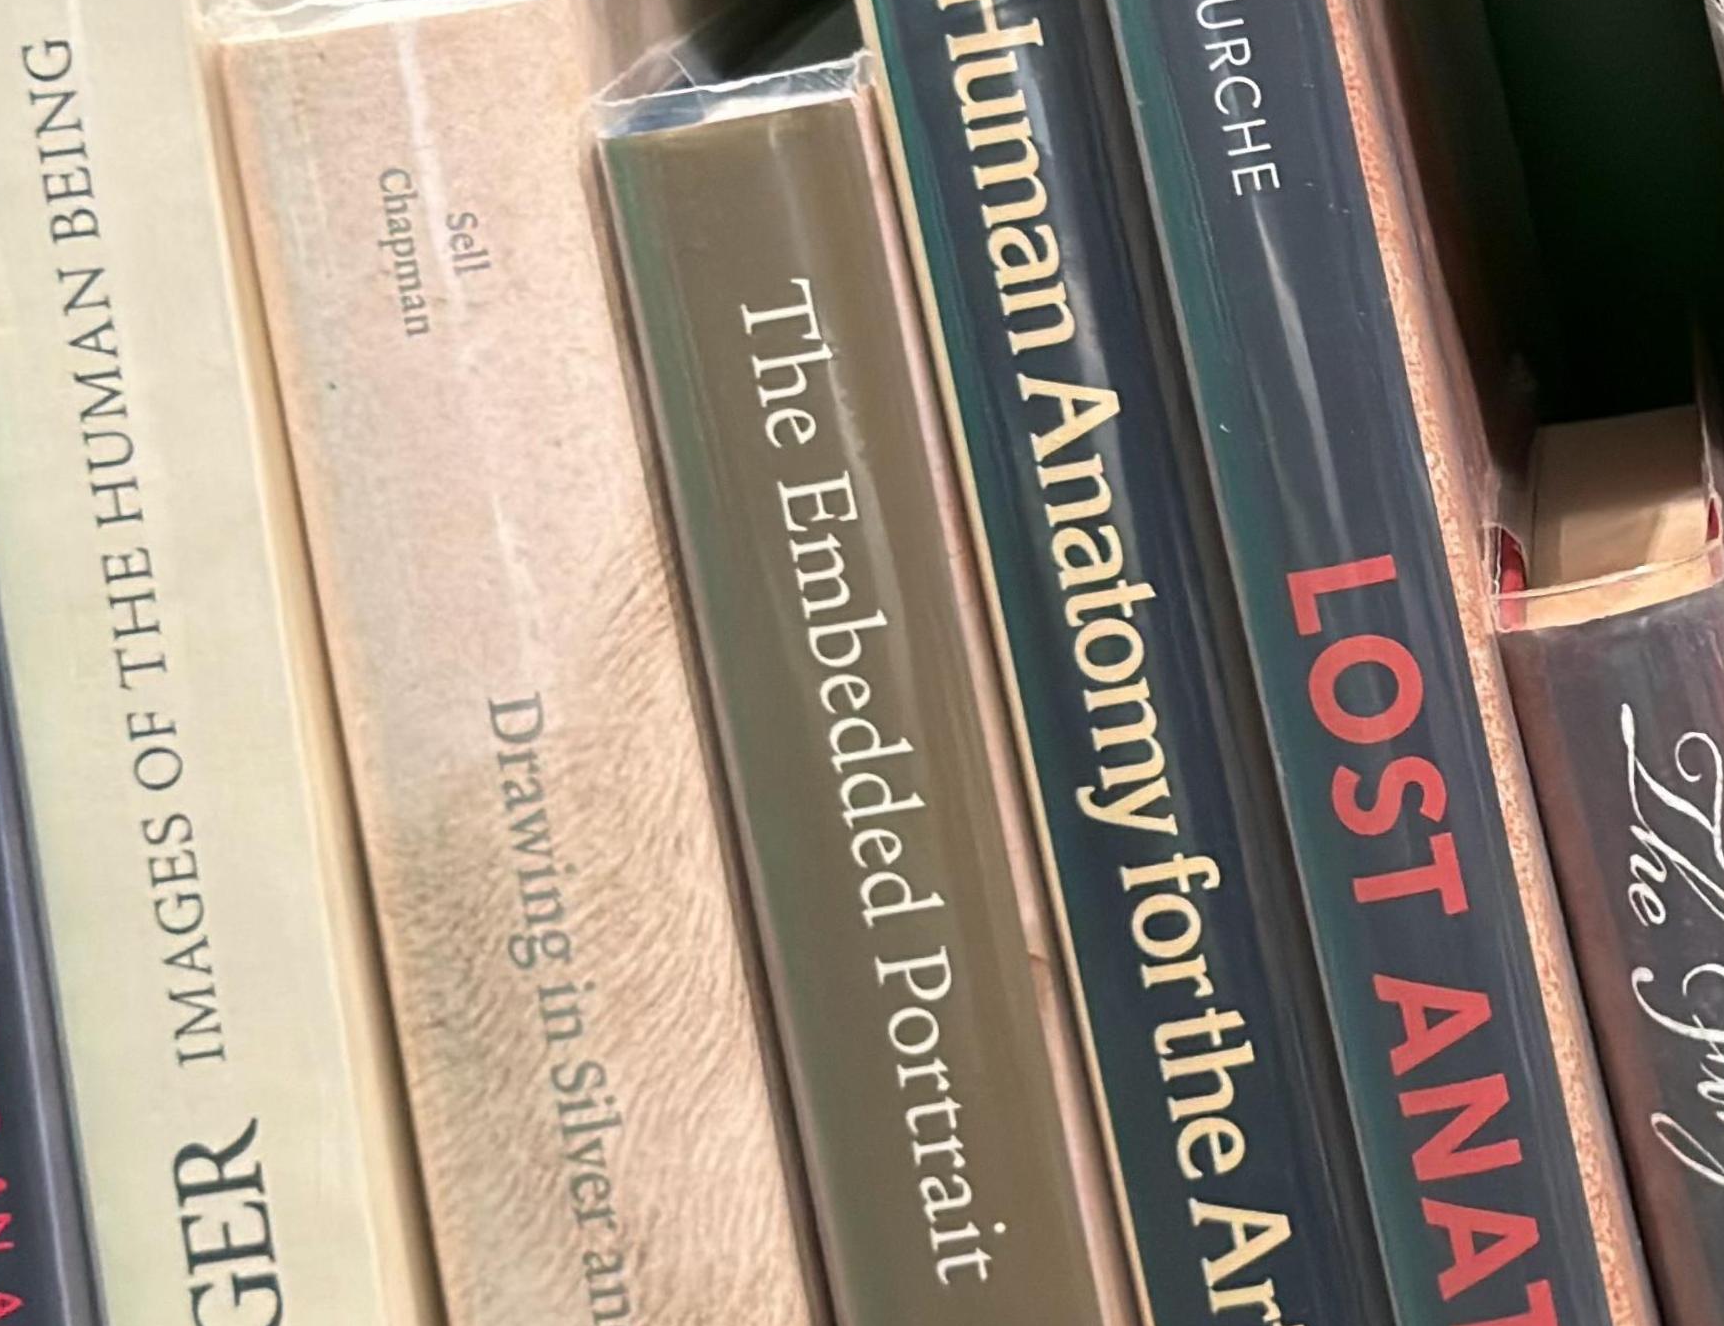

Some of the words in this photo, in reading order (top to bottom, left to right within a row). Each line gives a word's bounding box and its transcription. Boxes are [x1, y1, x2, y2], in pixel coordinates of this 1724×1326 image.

[21, 35, 101, 250] BEING
[377, 166, 430, 338] Chapman
[445, 210, 492, 277] Sell
[56, 265, 146, 528] HUMAN
[738, 275, 838, 449] The
[103, 545, 169, 690] THE
[1016, 369, 1181, 838] Anatomy
[125, 705, 185, 793] OF
[774, 469, 946, 931] Embedded
[1283, 554, 1471, 923] LOST
[487, 689, 577, 972] Drawing
[141, 810, 228, 1069] IMAGES
[537, 979, 597, 1046] in
[1117, 850, 1223, 1003] for
[549, 1056, 624, 1233] Silver
[874, 943, 1008, 1287] Portrait
[1150, 1008, 1257, 1181] the
